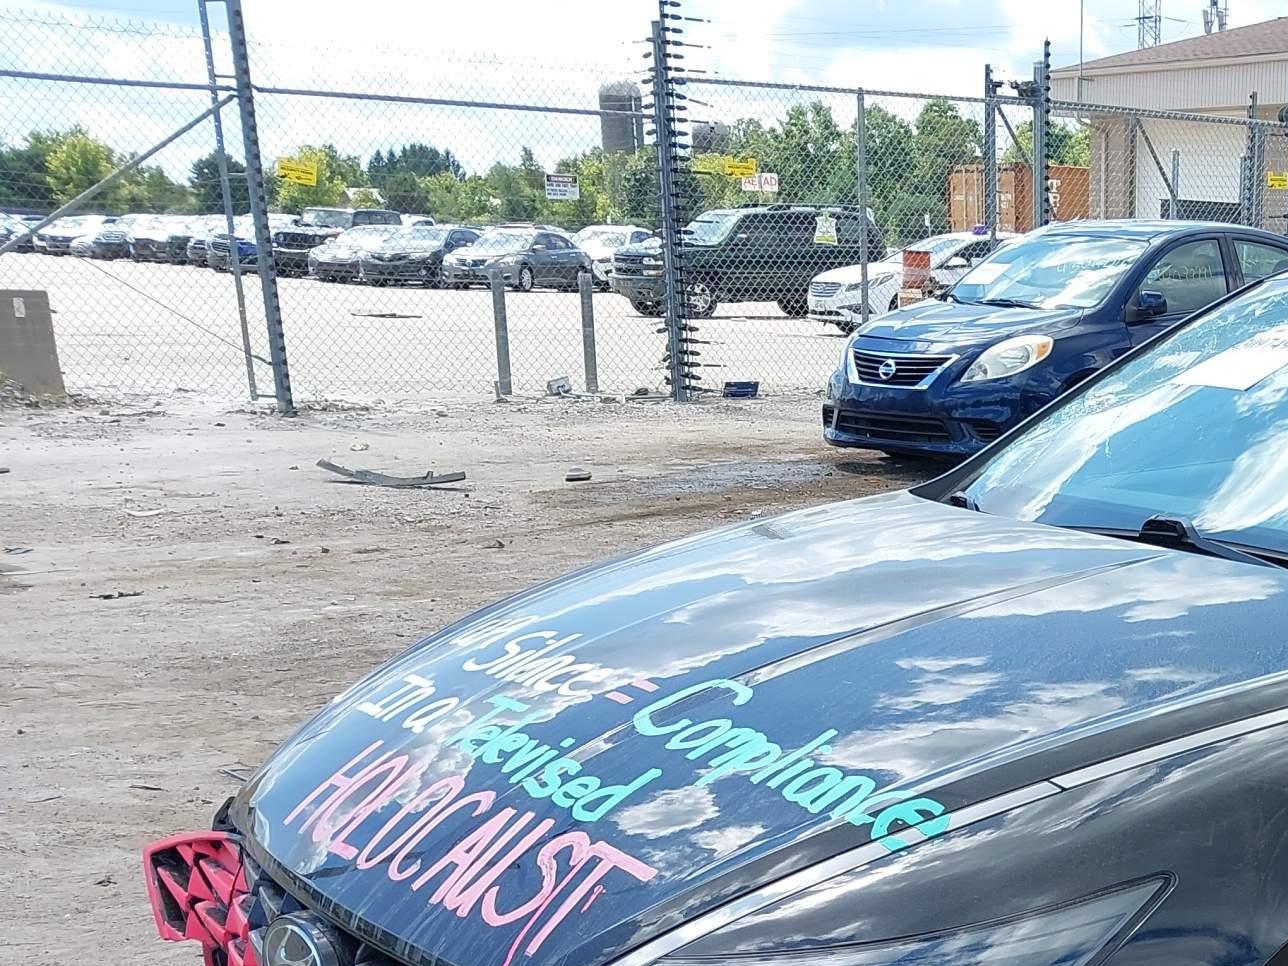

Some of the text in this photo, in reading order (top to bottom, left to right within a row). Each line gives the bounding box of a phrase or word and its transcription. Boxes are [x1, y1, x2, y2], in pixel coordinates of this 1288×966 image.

[355, 673, 663, 823] In a Televised
[632, 678, 952, 853] Compliance
[283, 739, 660, 958] HOLOCAUST
